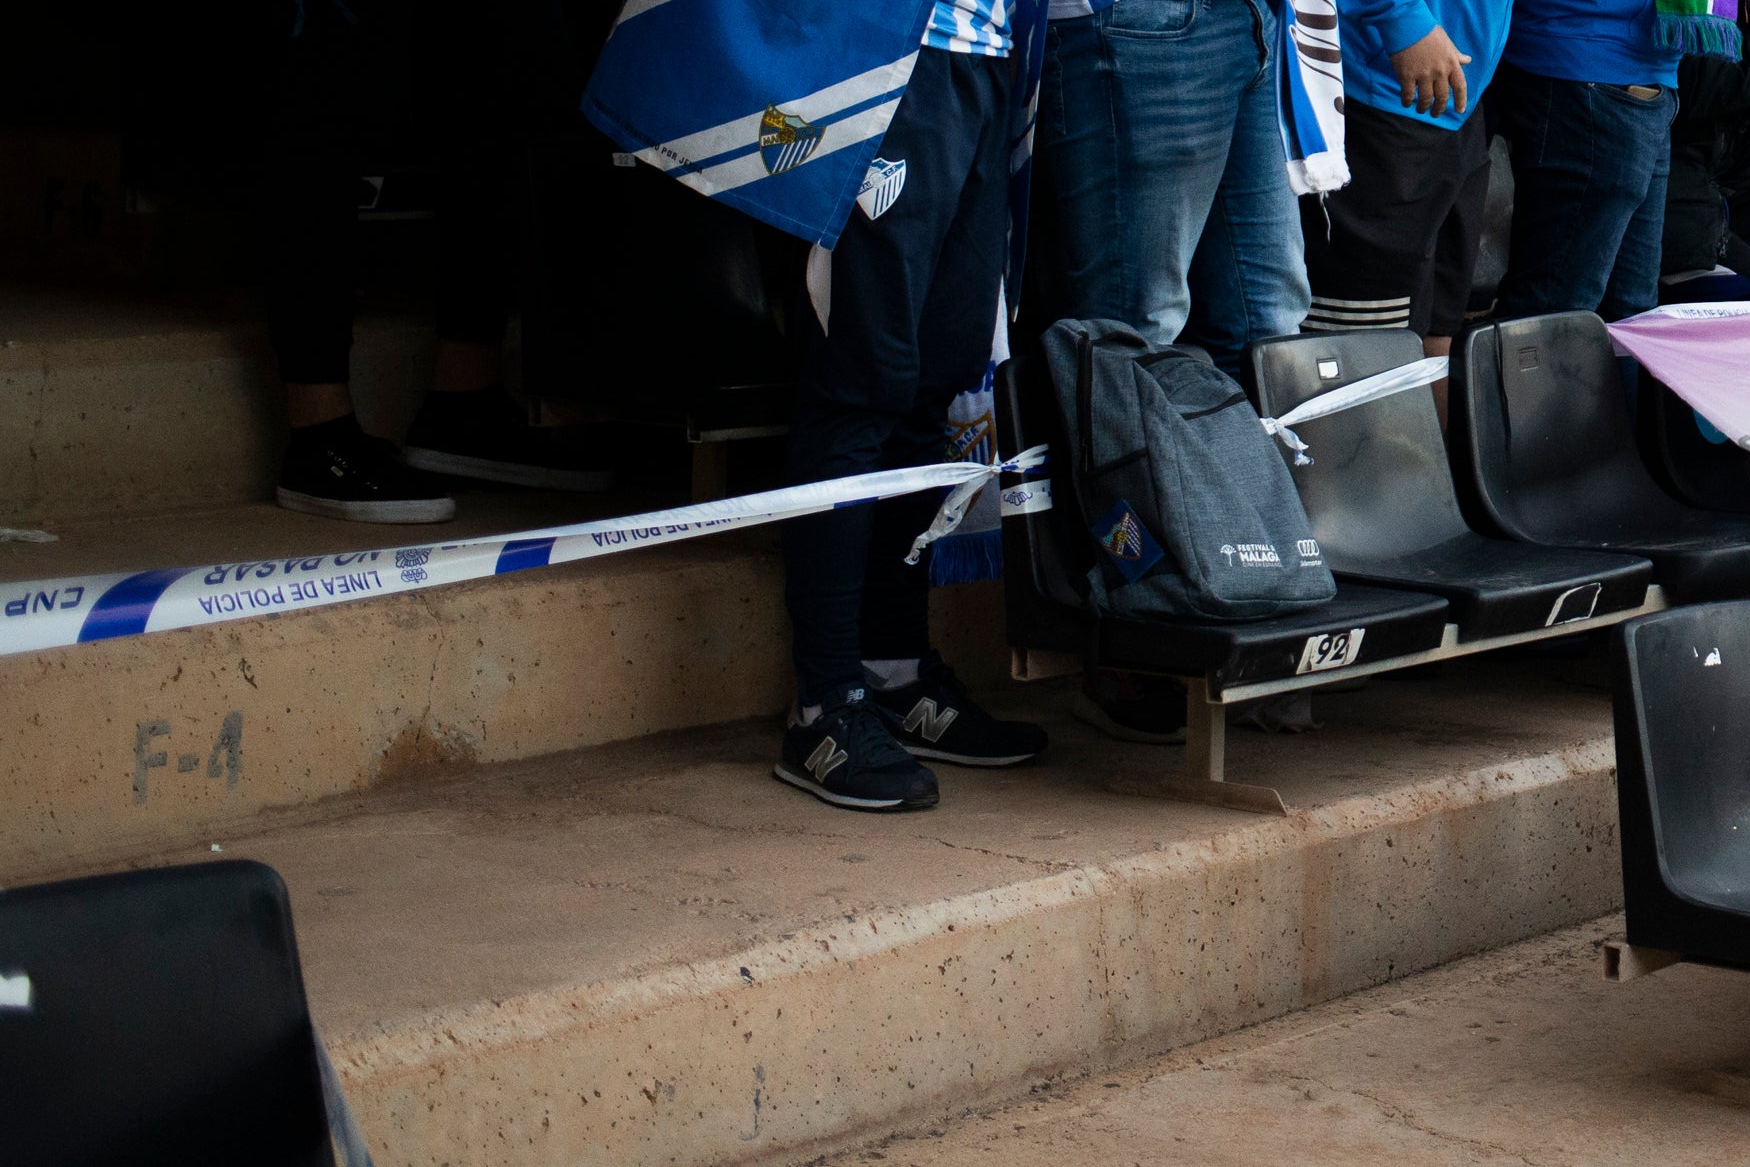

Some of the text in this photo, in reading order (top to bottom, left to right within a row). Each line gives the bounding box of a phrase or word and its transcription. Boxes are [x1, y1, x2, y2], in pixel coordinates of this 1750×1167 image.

[4, 585, 85, 617] CNP
[199, 569, 383, 615] LINEA DE POLICIA
[1316, 634, 1350, 665] 92
[902, 696, 959, 743] N
[804, 735, 849, 783] N
